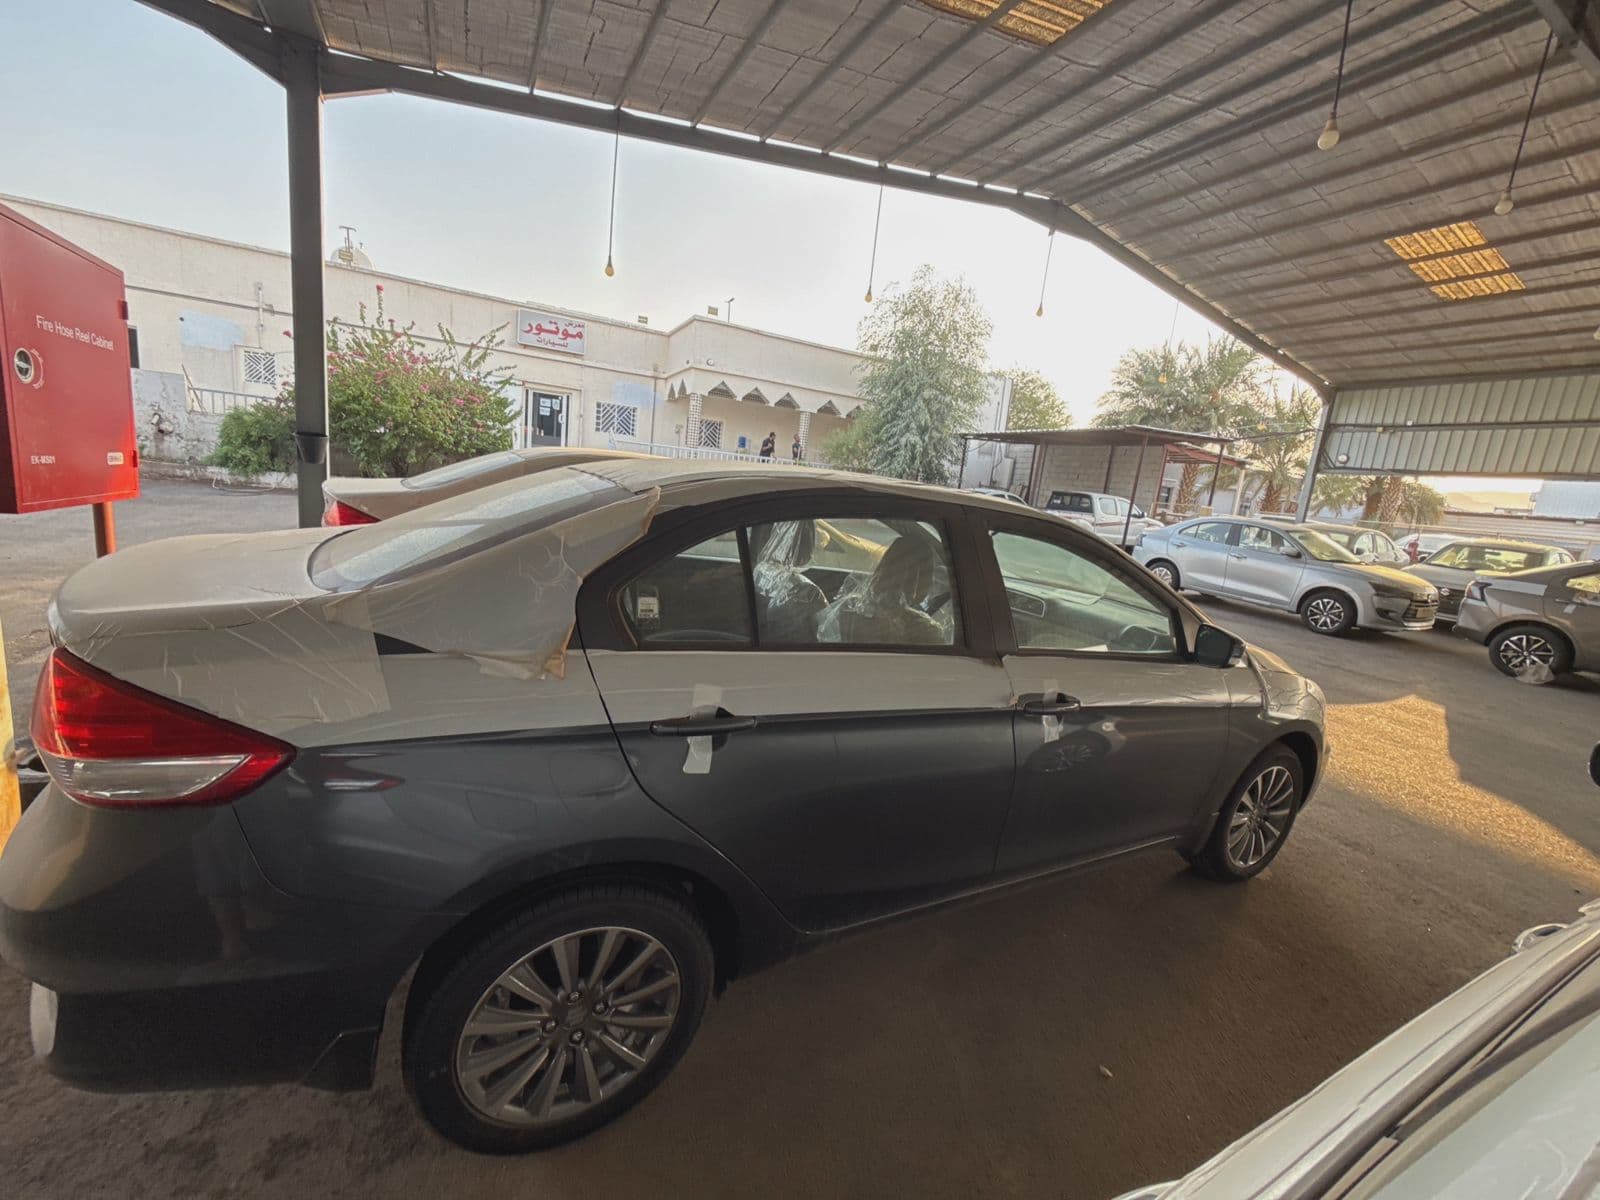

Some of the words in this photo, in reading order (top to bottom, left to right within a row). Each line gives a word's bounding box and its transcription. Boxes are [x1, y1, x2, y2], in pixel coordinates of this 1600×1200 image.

[36, 314, 53, 333] Fire
[54, 321, 74, 339] Hose
[75, 327, 91, 344] Reel
[91, 333, 114, 351] Cabinet
[520, 320, 584, 340] موتور
